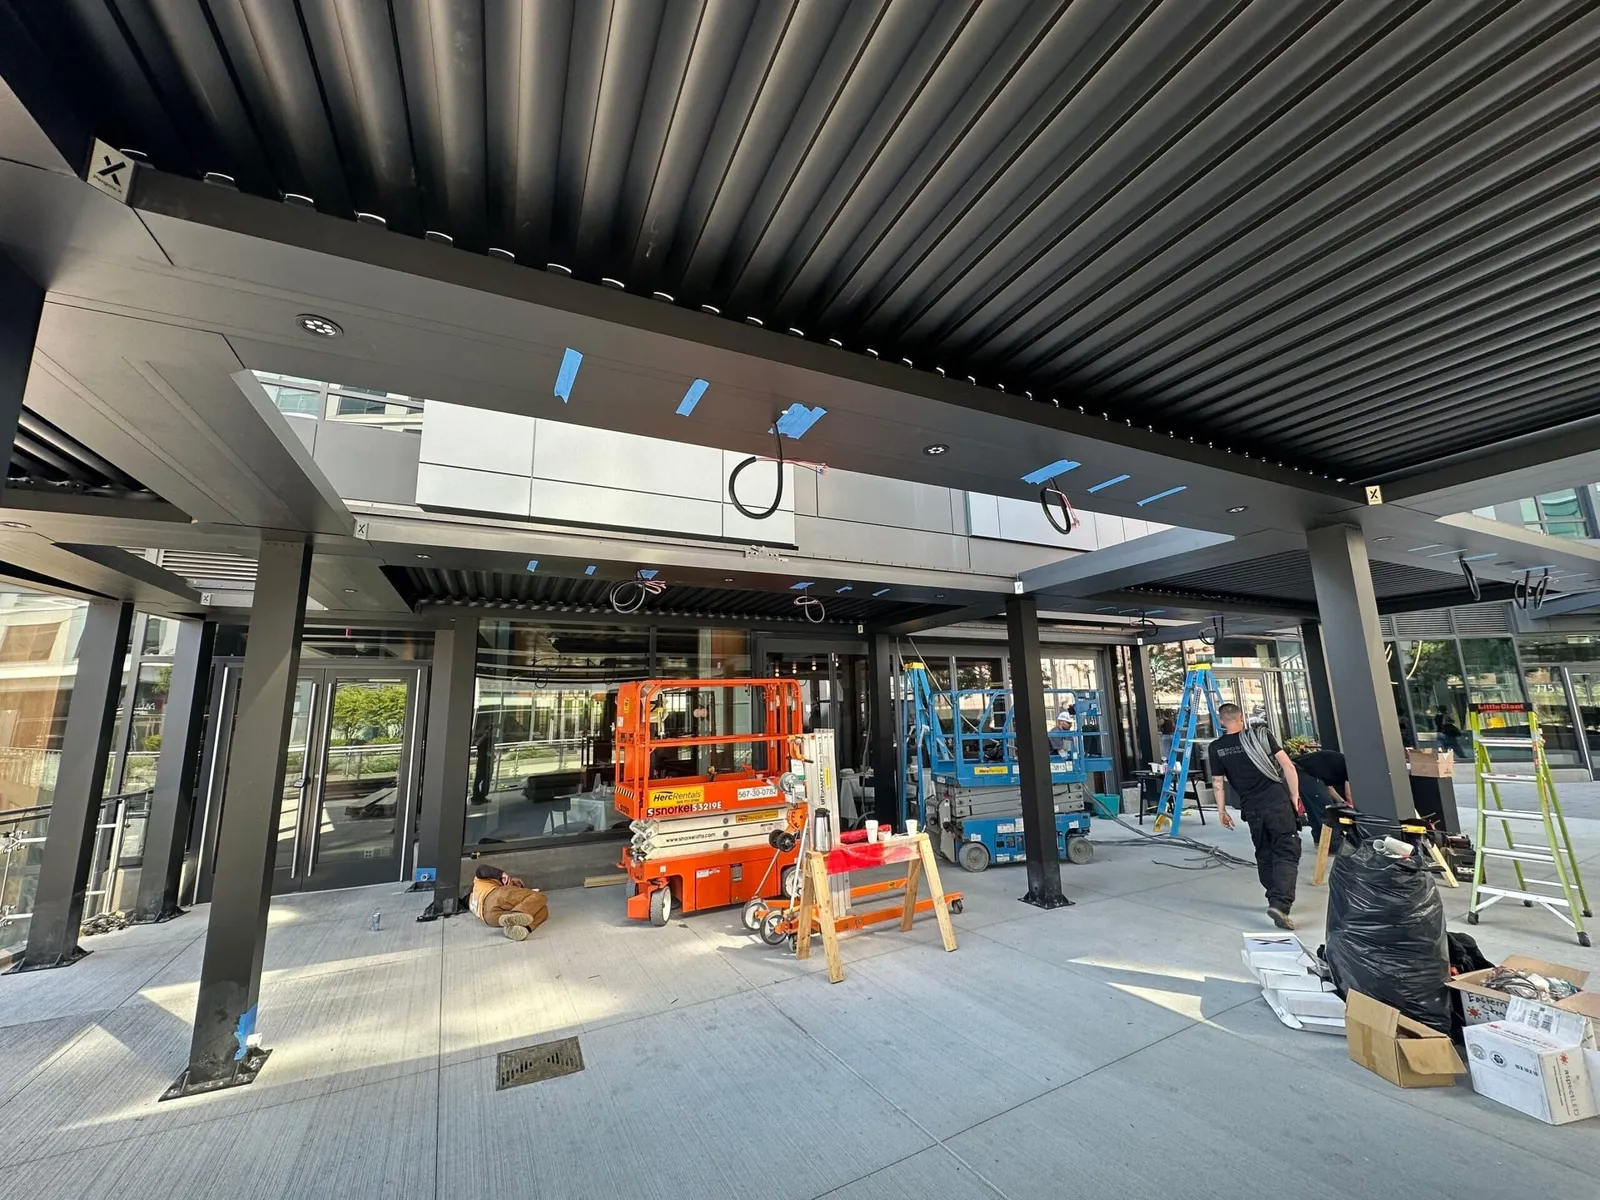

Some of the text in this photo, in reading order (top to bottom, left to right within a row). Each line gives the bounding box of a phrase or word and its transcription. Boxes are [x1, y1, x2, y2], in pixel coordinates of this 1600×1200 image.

[1533, 684, 1555, 693] 775
[655, 804, 693, 816] snorkel
[692, 801, 722, 812] S3219E
[1467, 992, 1508, 1009] Eastern
